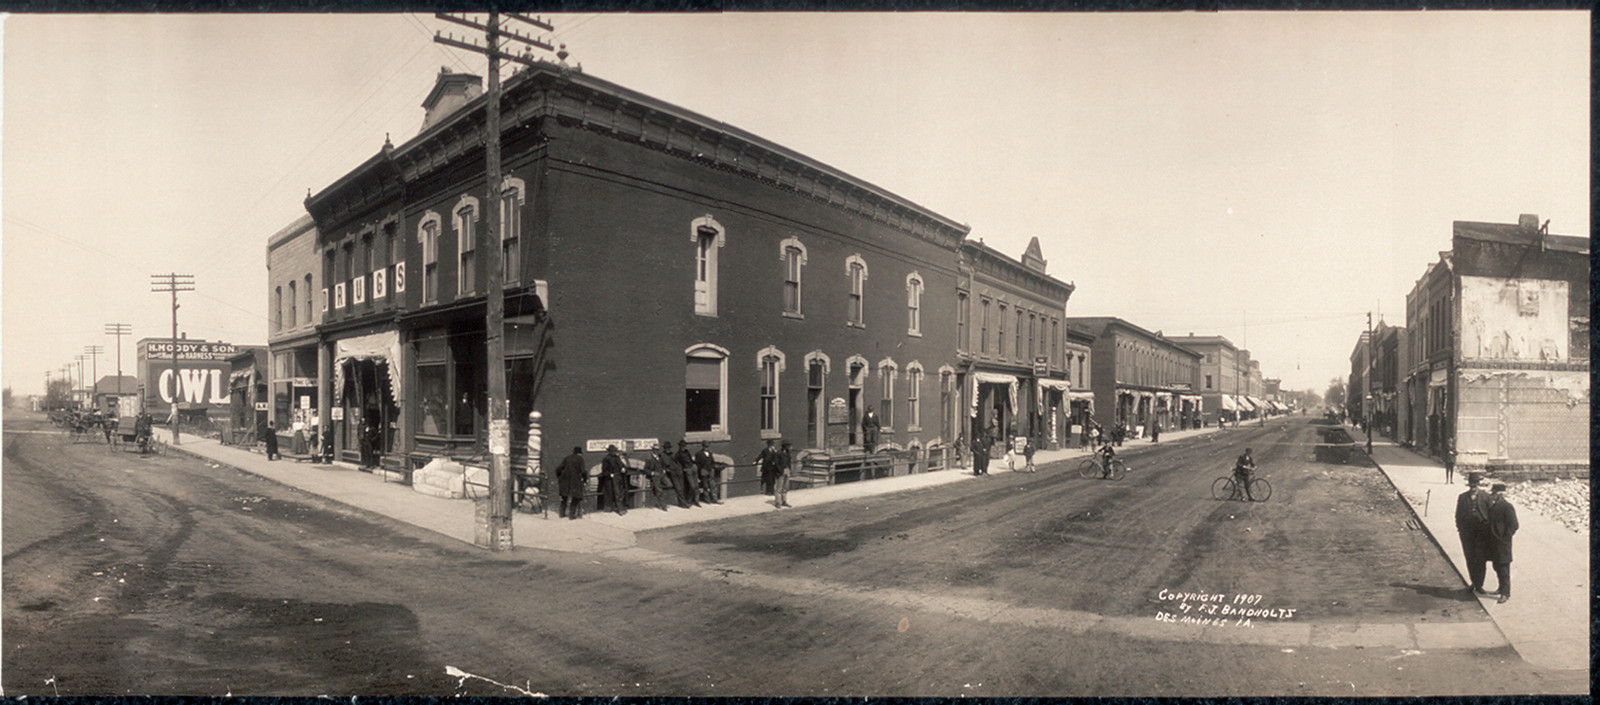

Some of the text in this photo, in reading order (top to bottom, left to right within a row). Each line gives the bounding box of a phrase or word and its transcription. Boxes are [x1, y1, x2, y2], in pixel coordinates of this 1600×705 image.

[323, 264, 404, 310] DRUGS
[200, 344, 208, 352] &
[159, 369, 231, 404] OWL
